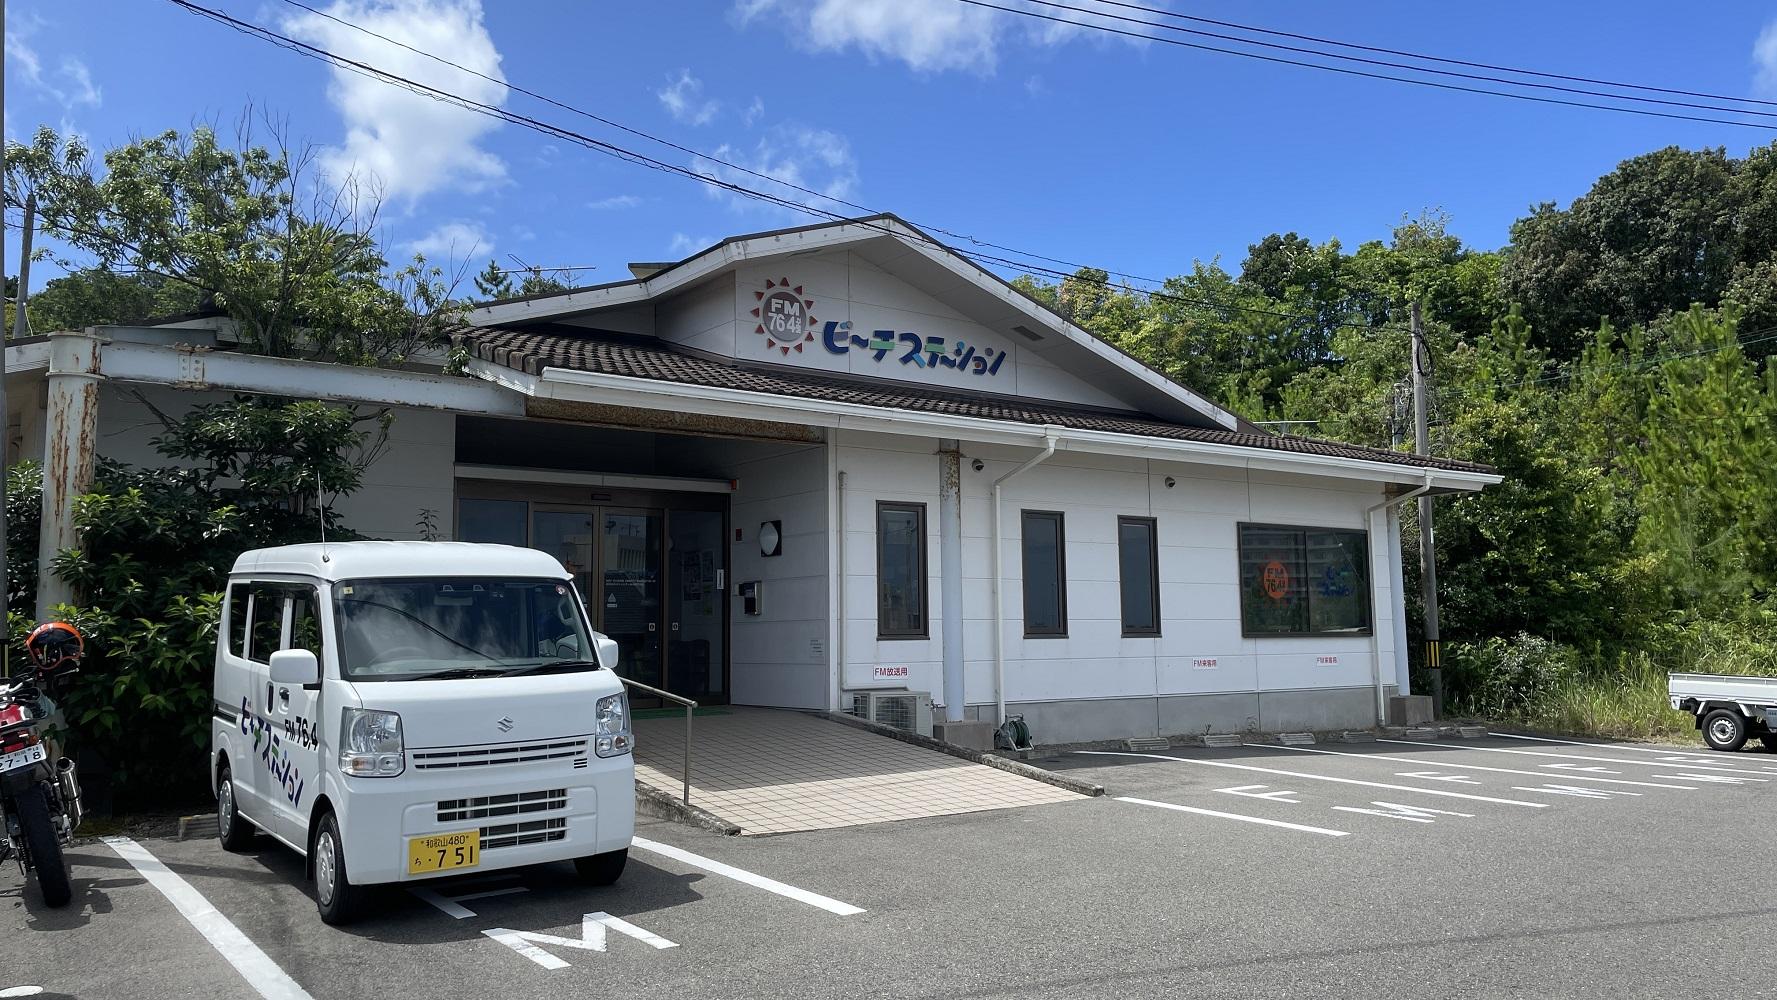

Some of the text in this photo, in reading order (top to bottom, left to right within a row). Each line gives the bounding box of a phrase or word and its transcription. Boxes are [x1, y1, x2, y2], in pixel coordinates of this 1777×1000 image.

[771, 298, 800, 316] FM
[874, 667, 908, 677] FM放送用
[284, 718, 296, 742] FM
